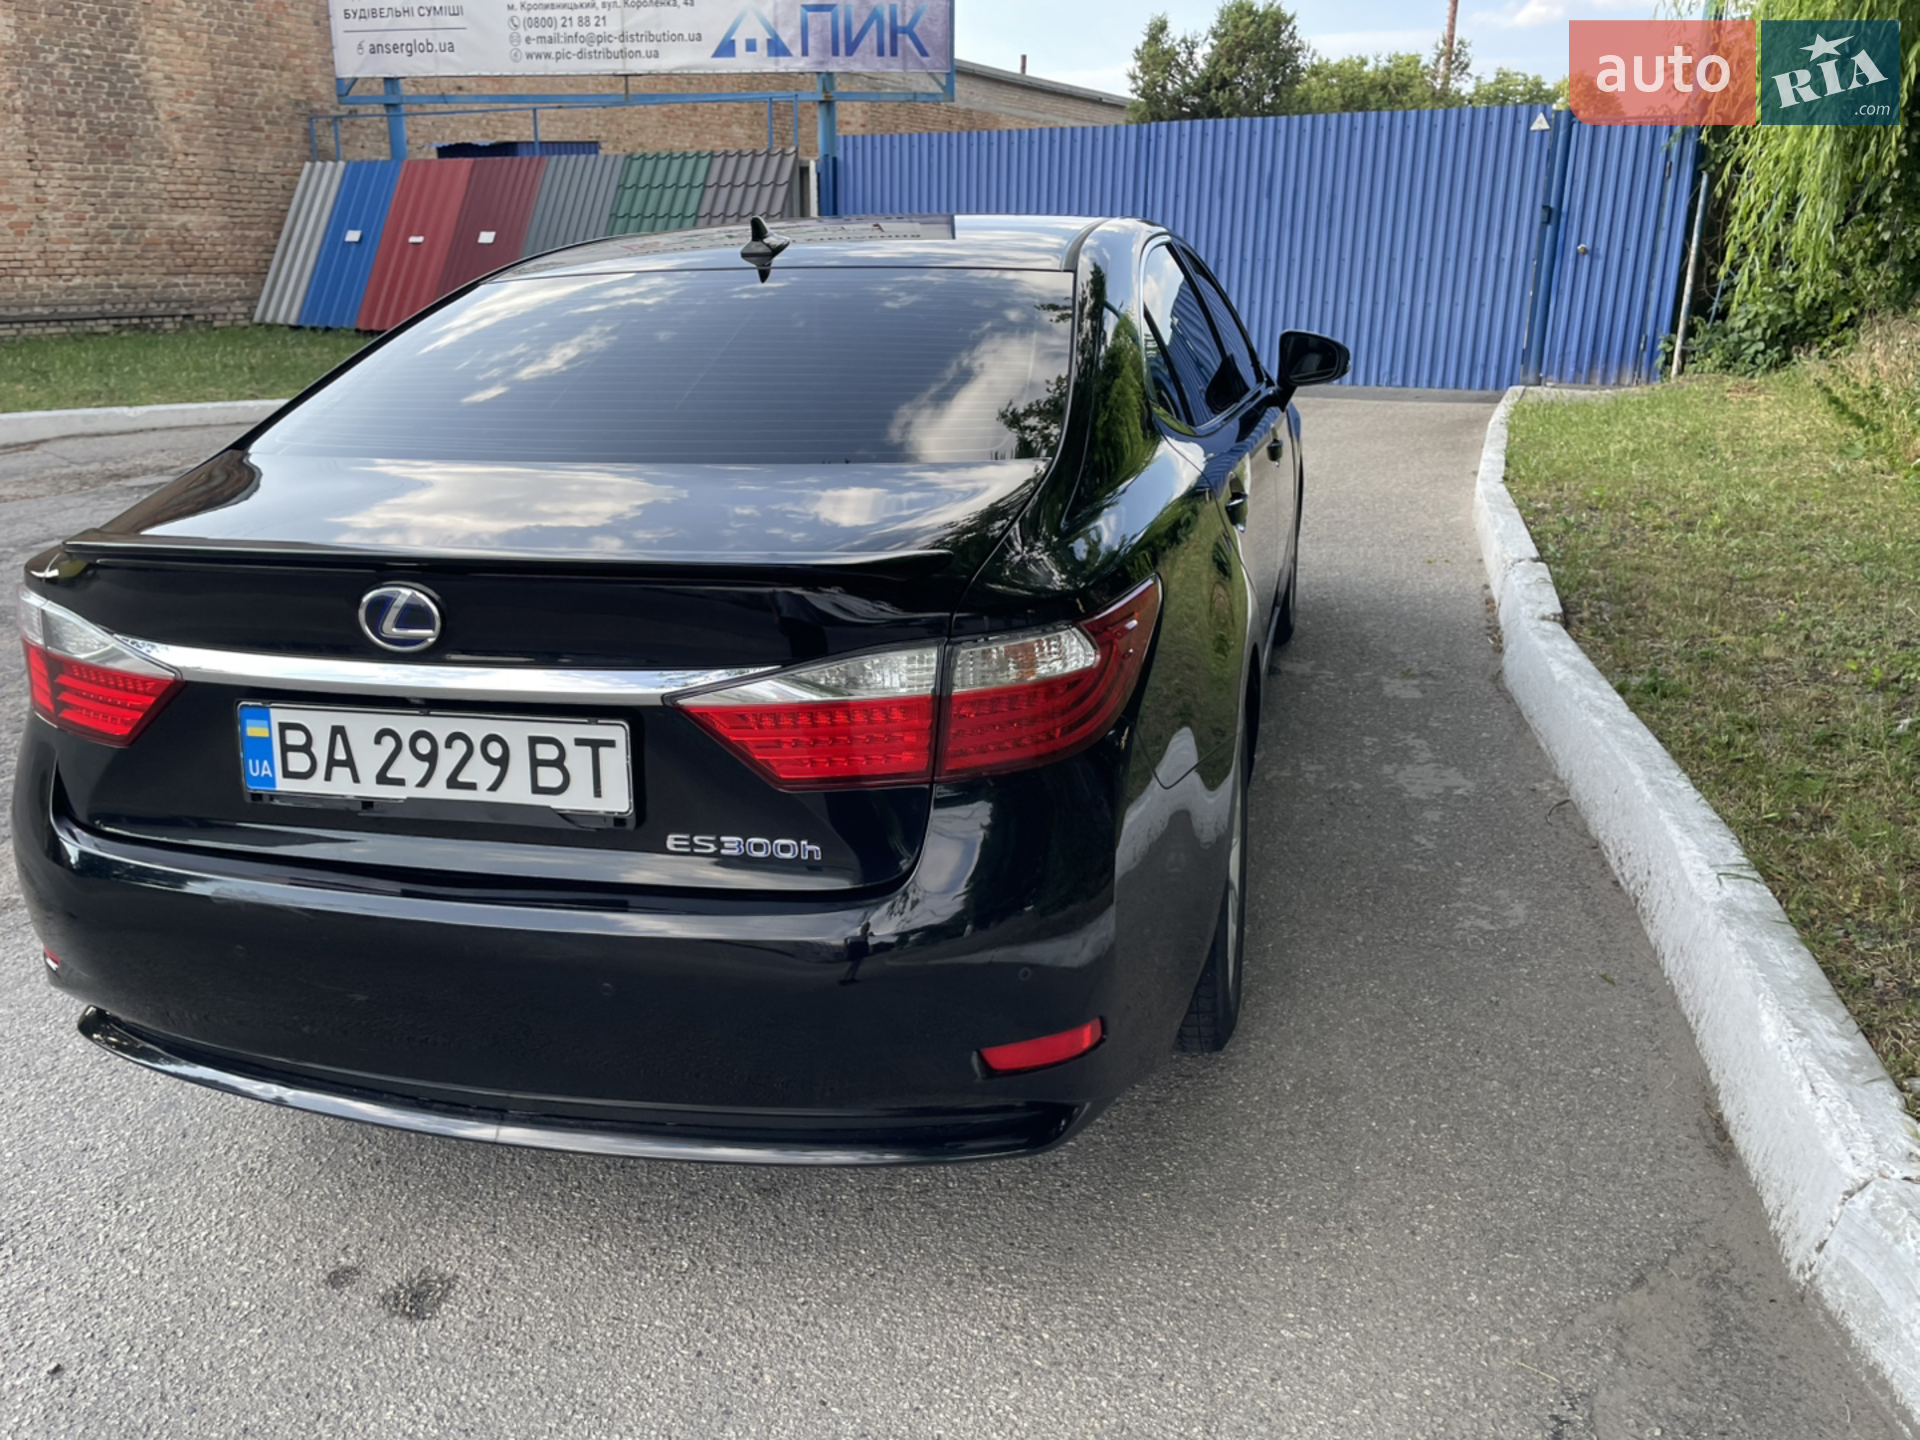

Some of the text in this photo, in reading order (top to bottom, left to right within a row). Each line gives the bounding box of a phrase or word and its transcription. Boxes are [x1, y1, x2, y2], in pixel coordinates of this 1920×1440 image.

[343, 5, 464, 20] БУДІВЕЛЬНІ СУМІШІ
[523, 15, 607, 31] (0800) 21 88 21
[800, 3, 930, 58] ПИК
[368, 38, 455, 57] anserglob.ua
[525, 47, 660, 63] www.pic-distribution.ua
[248, 758, 273, 778] UA
[276, 720, 617, 799] BA 2929 BT
[665, 834, 823, 862] ES300h
